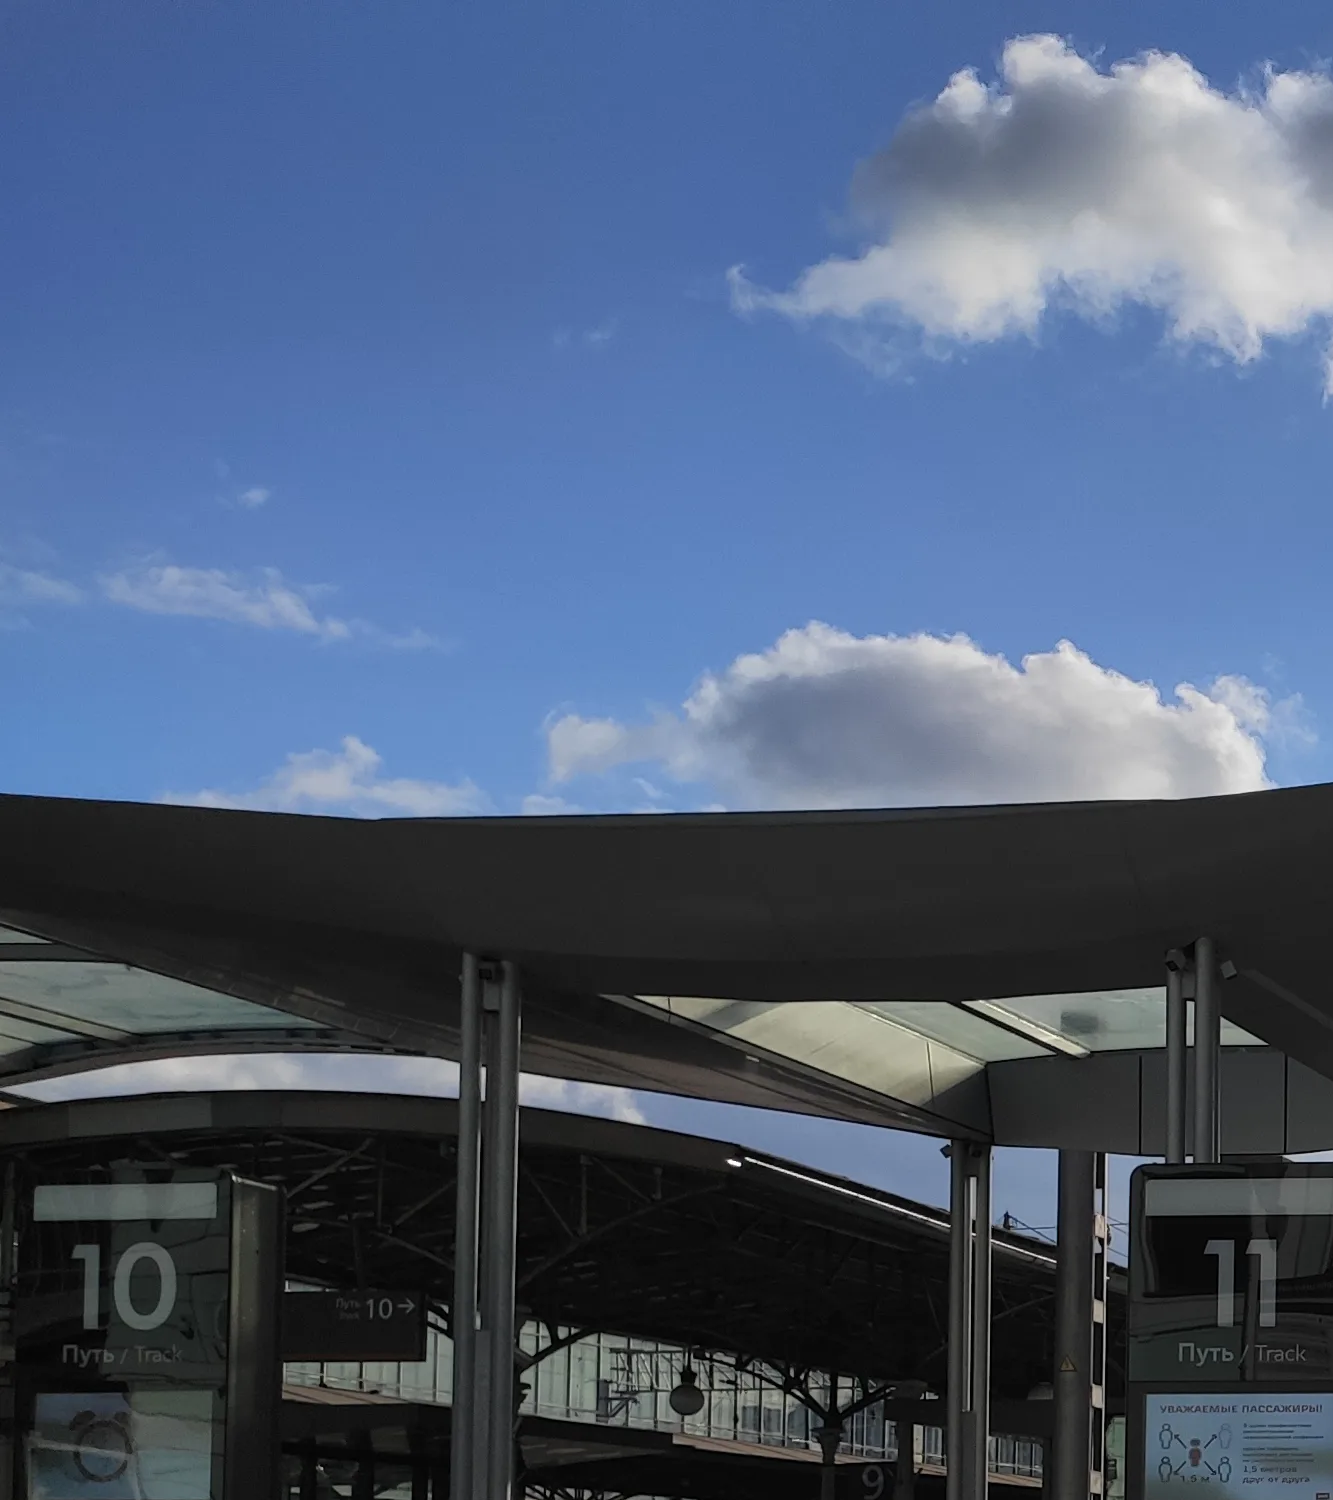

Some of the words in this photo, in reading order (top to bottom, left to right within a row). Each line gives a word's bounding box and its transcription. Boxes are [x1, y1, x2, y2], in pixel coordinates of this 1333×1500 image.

[71, 1241, 177, 1331] 10
[1203, 1239, 1277, 1328] 11
[366, 1297, 393, 1320] 10
[62, 1344, 115, 1369] Путь
[134, 1343, 183, 1364] Track
[1178, 1343, 1235, 1367] Путь
[1255, 1344, 1306, 1363] Track
[1159, 1404, 1238, 1414] УВАЖАЕМЫЕ
[1241, 1404, 1323, 1414] ПАССАЖИРЫ!
[862, 1465, 885, 1500] 9
